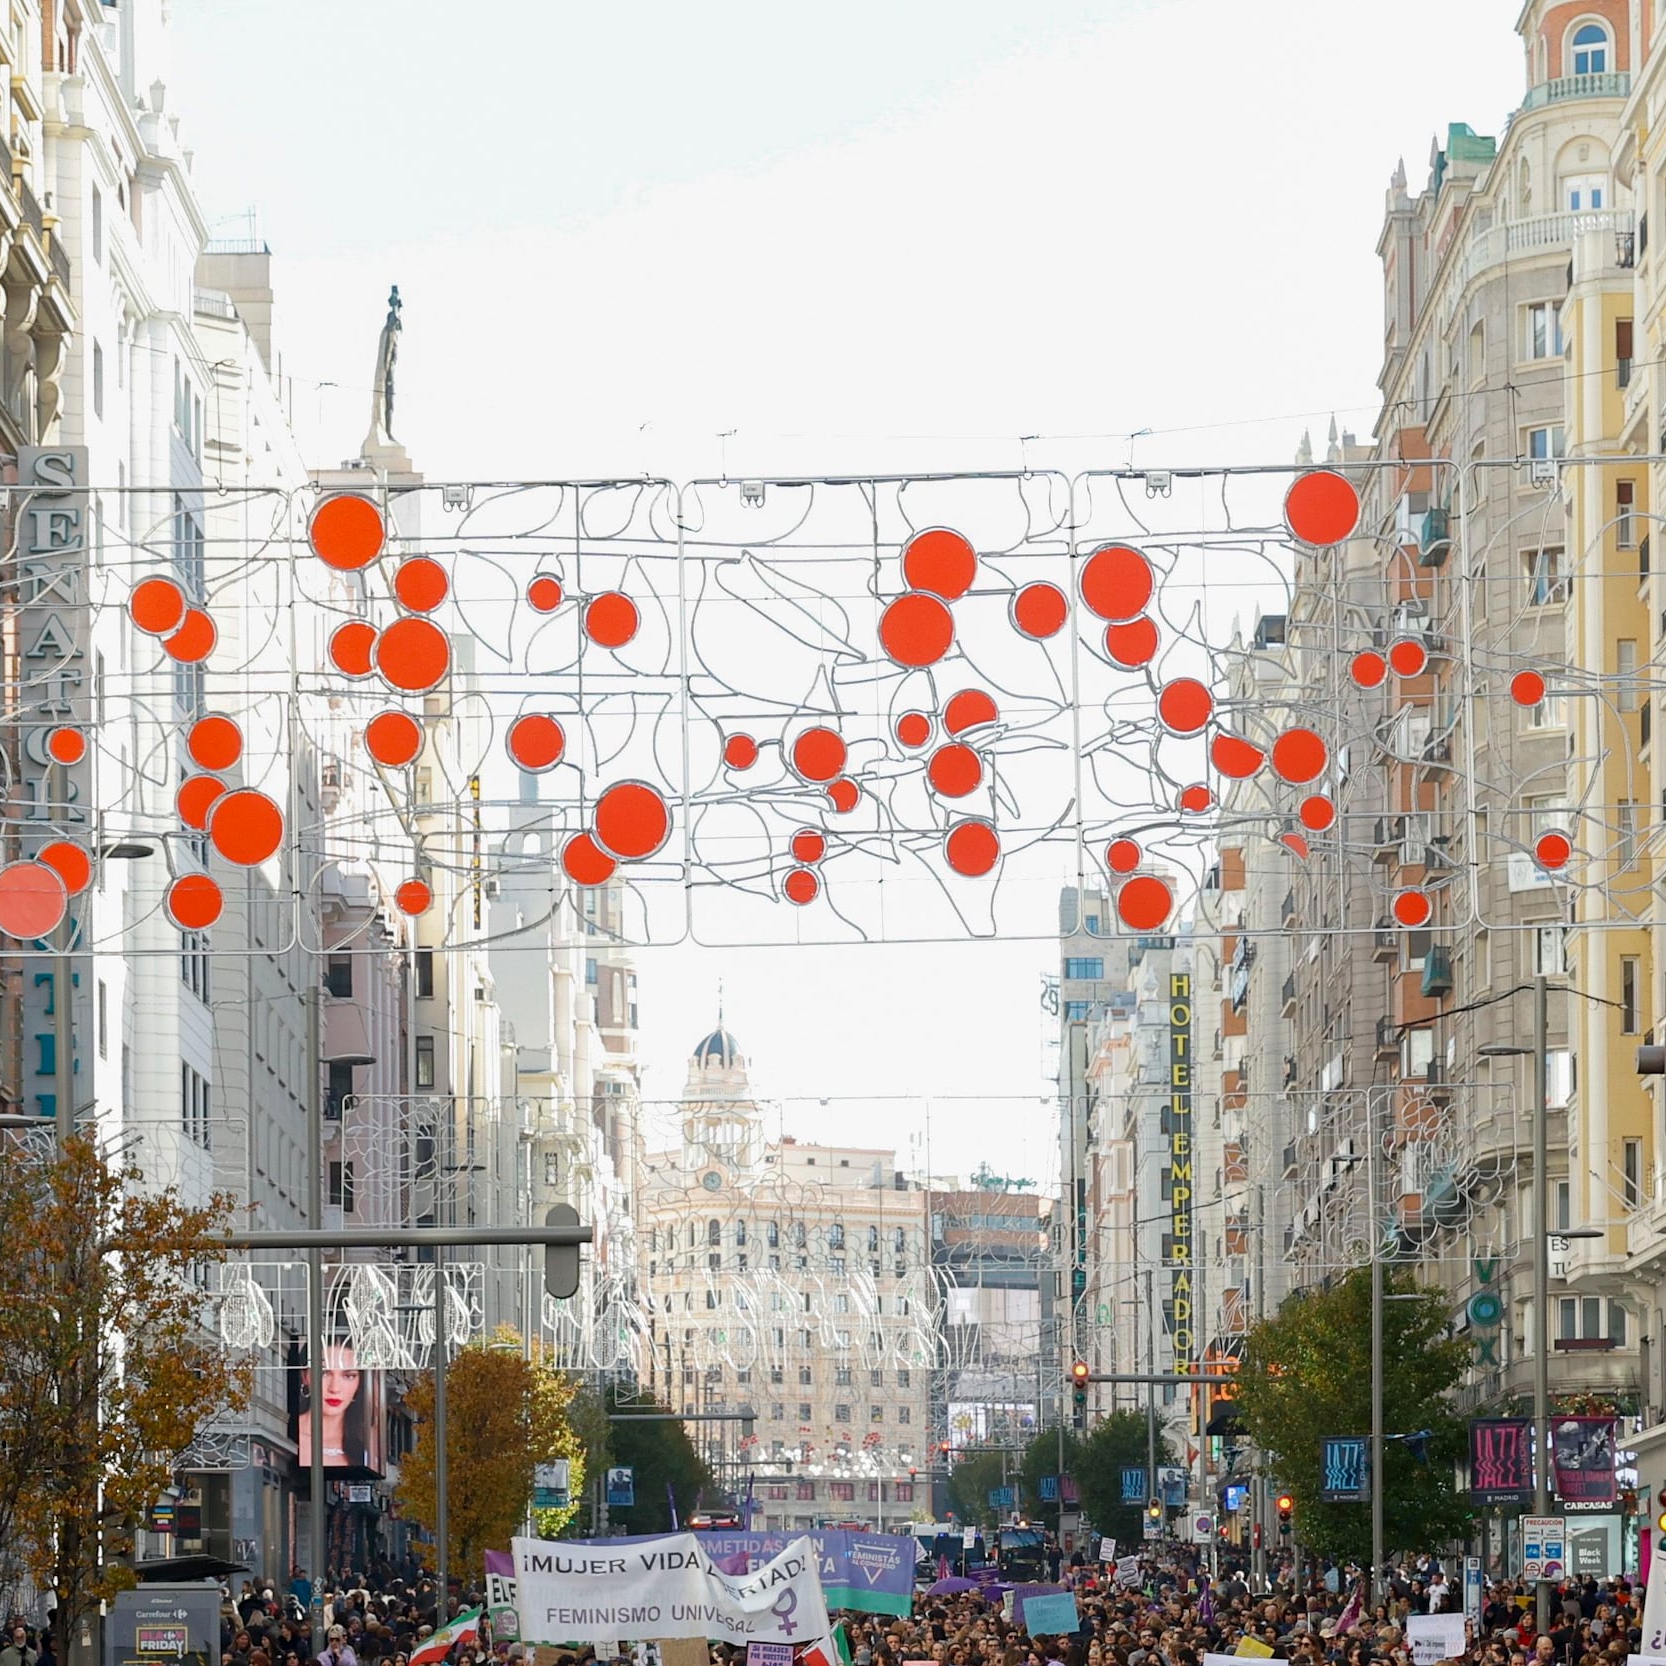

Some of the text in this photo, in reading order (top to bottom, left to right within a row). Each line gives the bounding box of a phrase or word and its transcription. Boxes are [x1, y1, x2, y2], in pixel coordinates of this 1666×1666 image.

[1171, 973, 1191, 1114] HOTEL
[1171, 1133, 1193, 1375] EMPERADOR
[1564, 1501, 1613, 1510] CARCASAS
[640, 1552, 700, 1571] VIDA
[547, 1606, 661, 1624] FEMINISMO
[141, 1641, 184, 1650] FRIDAY
